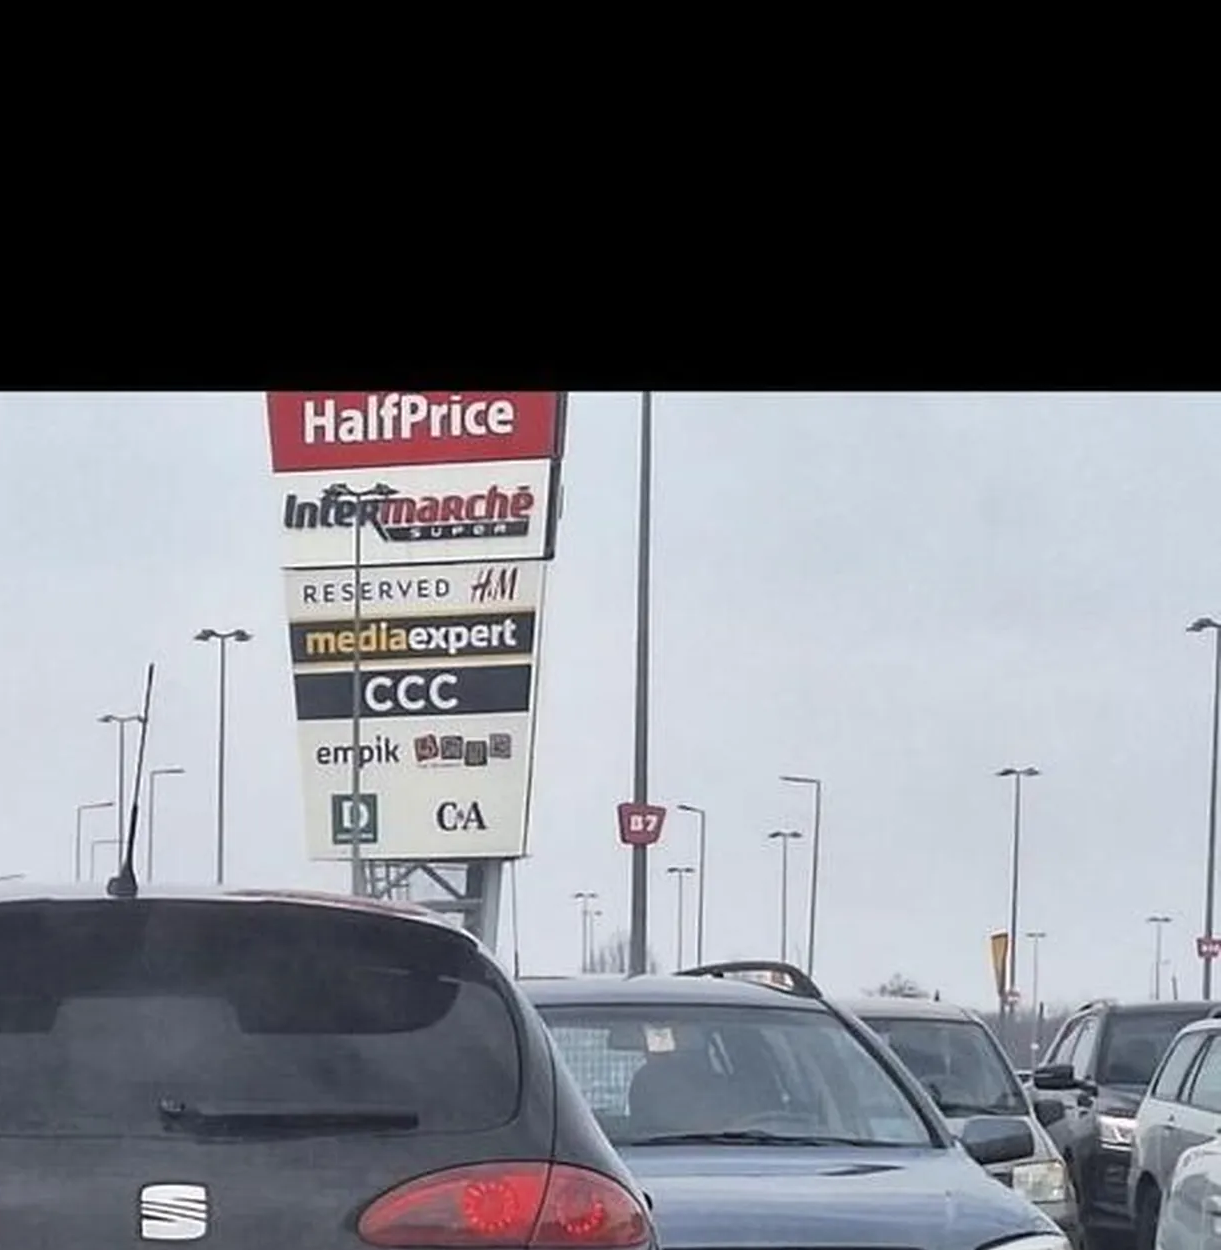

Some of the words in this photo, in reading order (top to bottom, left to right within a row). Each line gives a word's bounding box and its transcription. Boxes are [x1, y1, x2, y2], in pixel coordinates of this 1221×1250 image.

[304, 393, 514, 444] HalfPrice
[410, 524, 507, 539] SUPER
[303, 578, 451, 604] RESERVED
[471, 567, 518, 602] H&M
[306, 618, 518, 654] mediaexpert
[365, 673, 459, 712] CCC
[316, 735, 401, 766] empik
[341, 800, 370, 829] D
[436, 801, 487, 831] C&A
